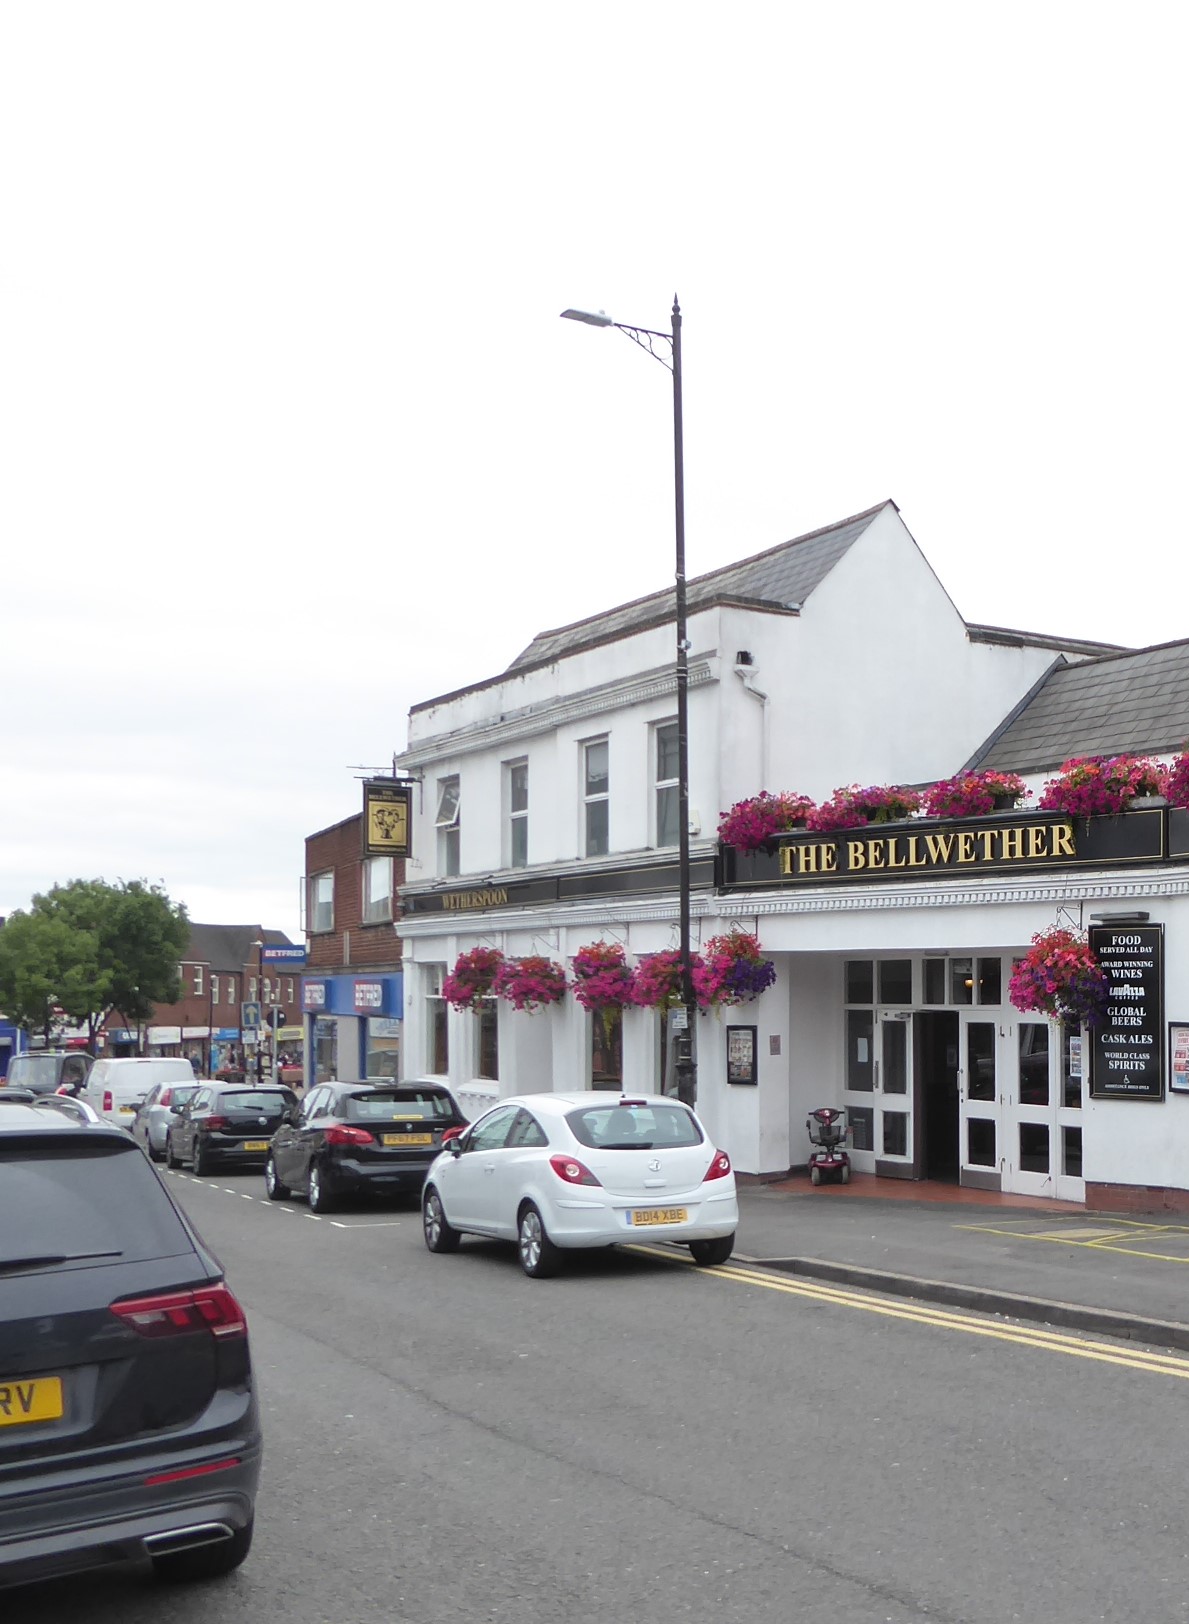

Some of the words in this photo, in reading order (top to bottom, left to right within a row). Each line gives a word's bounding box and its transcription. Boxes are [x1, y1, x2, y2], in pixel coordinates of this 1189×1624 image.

[780, 843, 837, 874] THE
[847, 824, 1076, 870] BELLWETHER
[442, 887, 508, 910] WETHERSPOON
[1112, 935, 1142, 945] FOOD
[1099, 946, 1125, 954] SERVED
[1111, 969, 1143, 978] WINES
[1109, 984, 1145, 996] LAVAZZA
[1107, 1006, 1147, 1016] GLOBAL
[1111, 1016, 1142, 1026] BEERS
[1101, 1034, 1127, 1043] CASK
[1128, 1034, 1153, 1044] ALES
[1104, 1051, 1128, 1059] WORLD
[1129, 1052, 1150, 1060] CLASS
[1108, 1060, 1145, 1070] SPIRITS
[635, 1211, 659, 1222] BD14
[661, 1209, 683, 1220] XBE
[0, 1383, 36, 1416] RV
